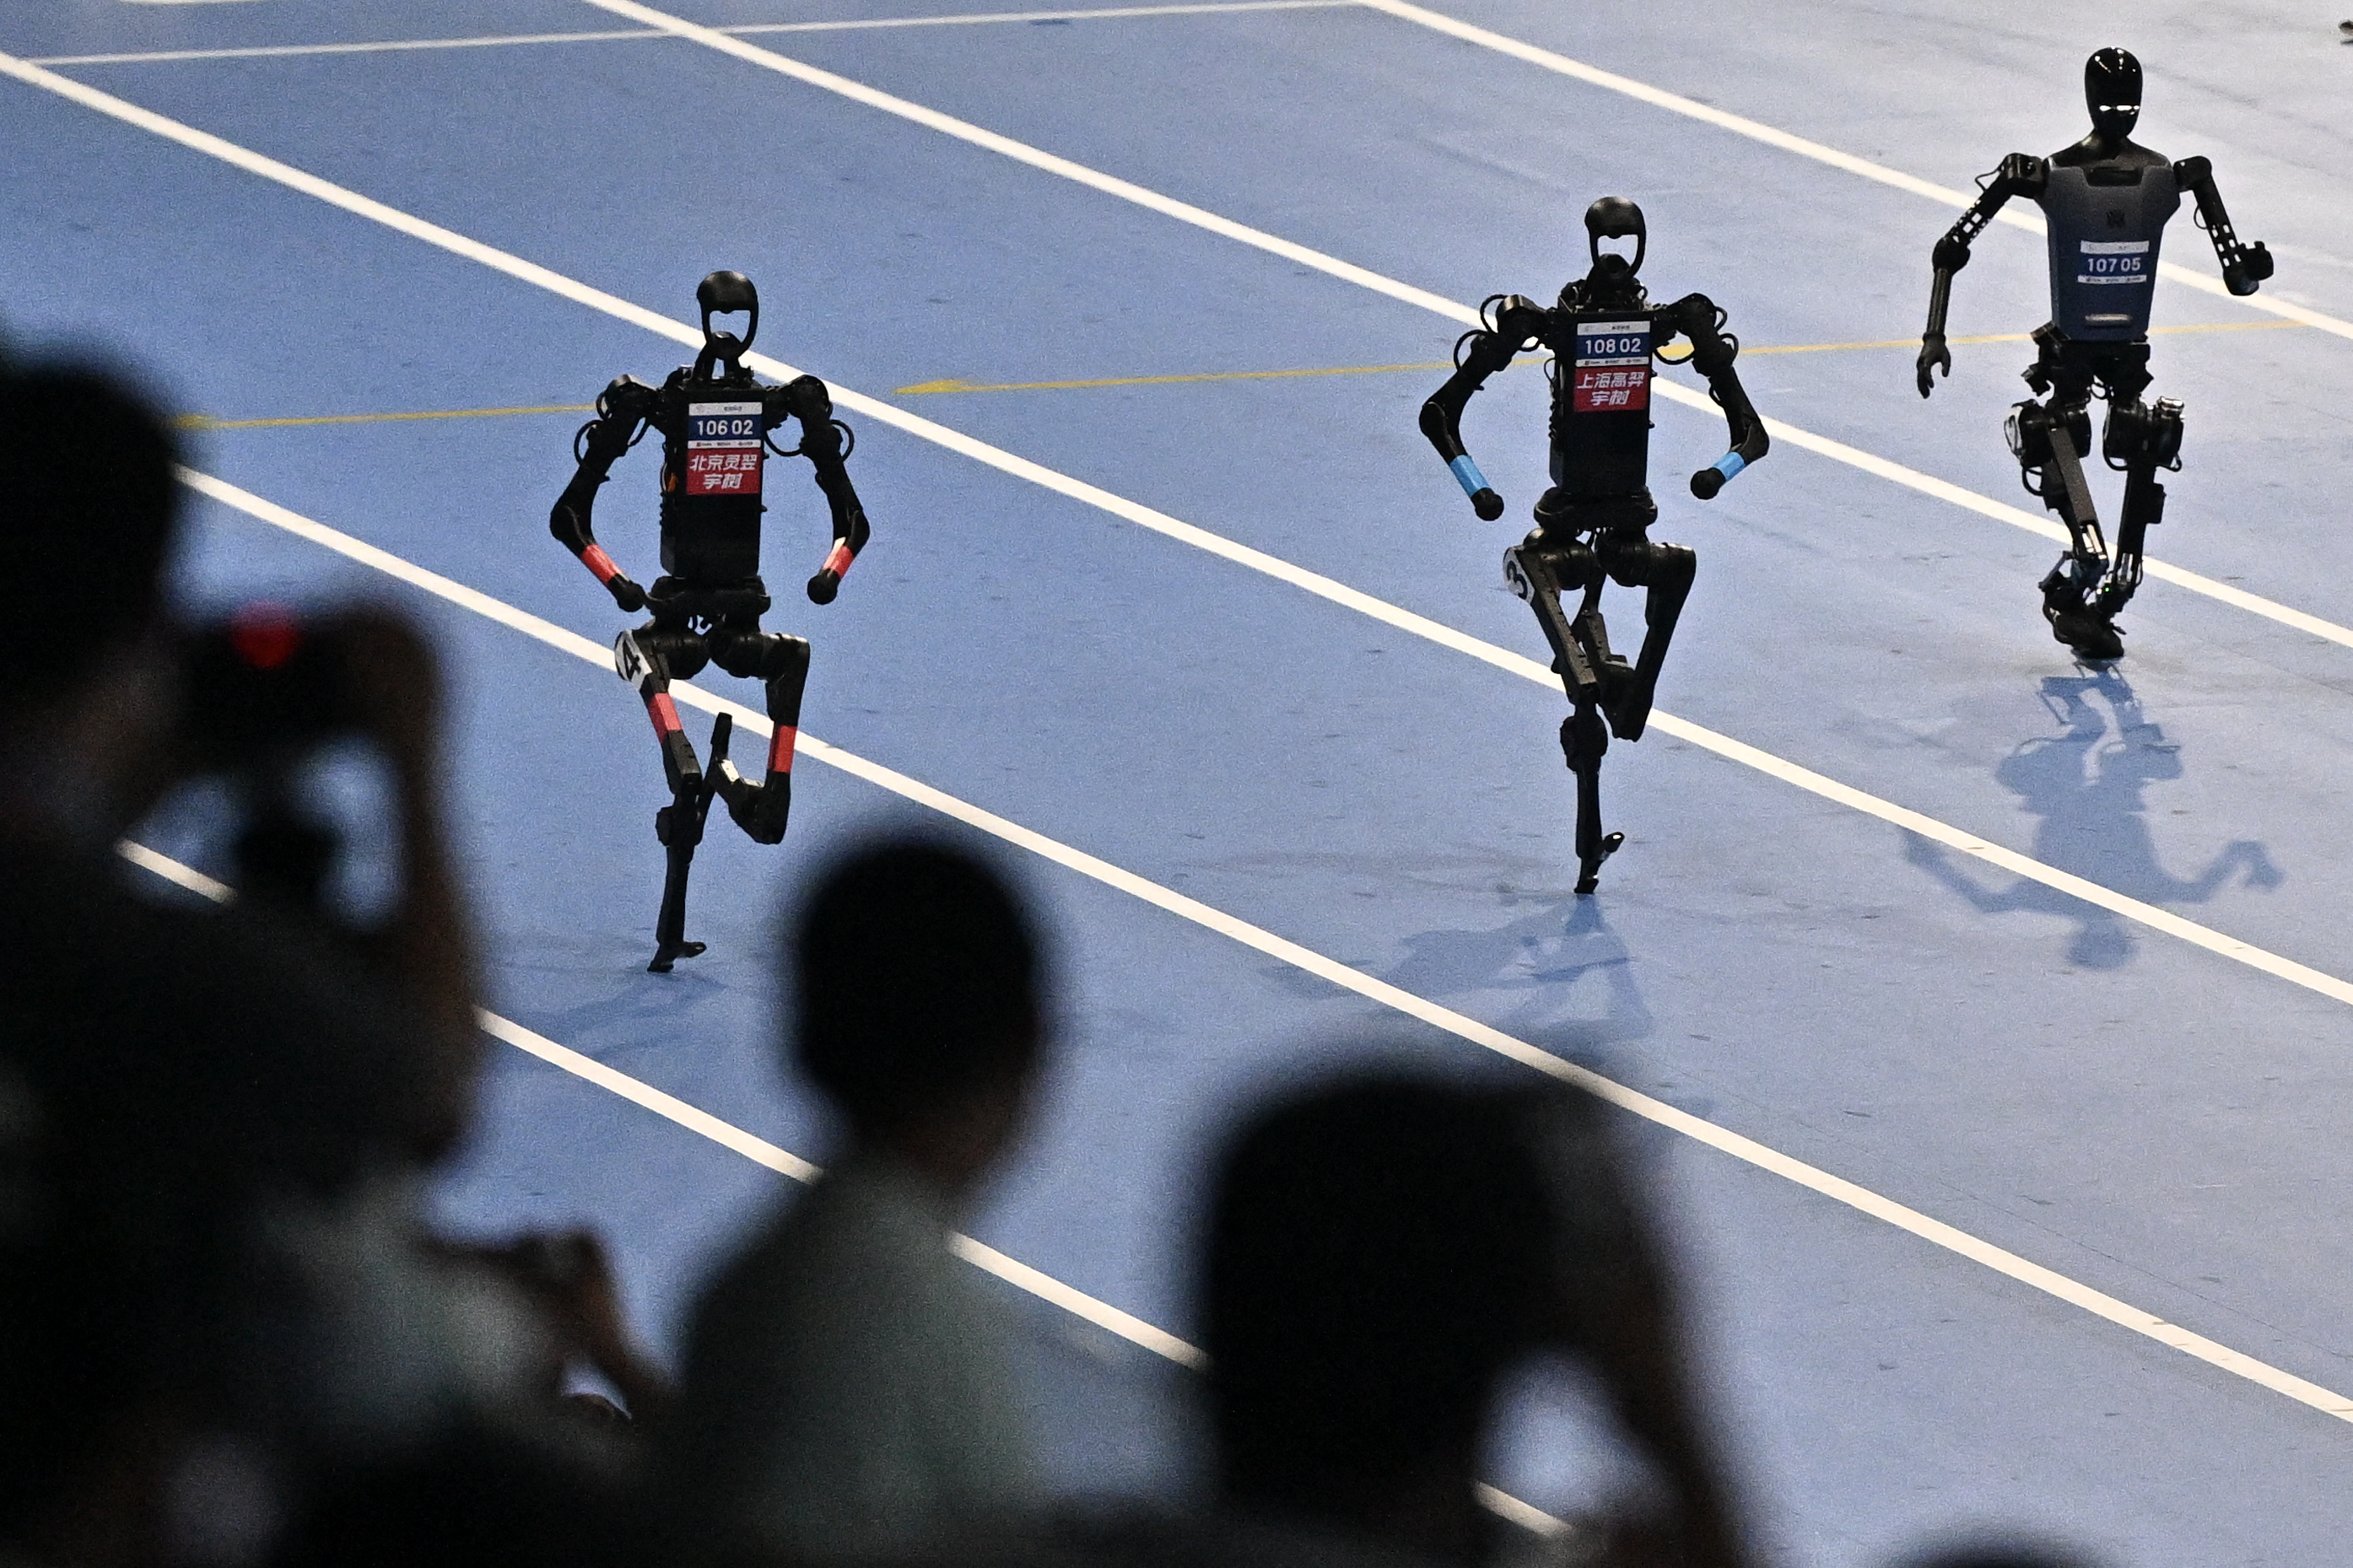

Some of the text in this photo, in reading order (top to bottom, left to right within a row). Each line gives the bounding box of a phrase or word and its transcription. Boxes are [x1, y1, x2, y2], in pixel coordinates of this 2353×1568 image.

[1589, 389, 1631, 407] 宇树
[702, 472, 743, 490] 宇树
[1506, 560, 1528, 600] 3
[623, 639, 641, 682] 4
